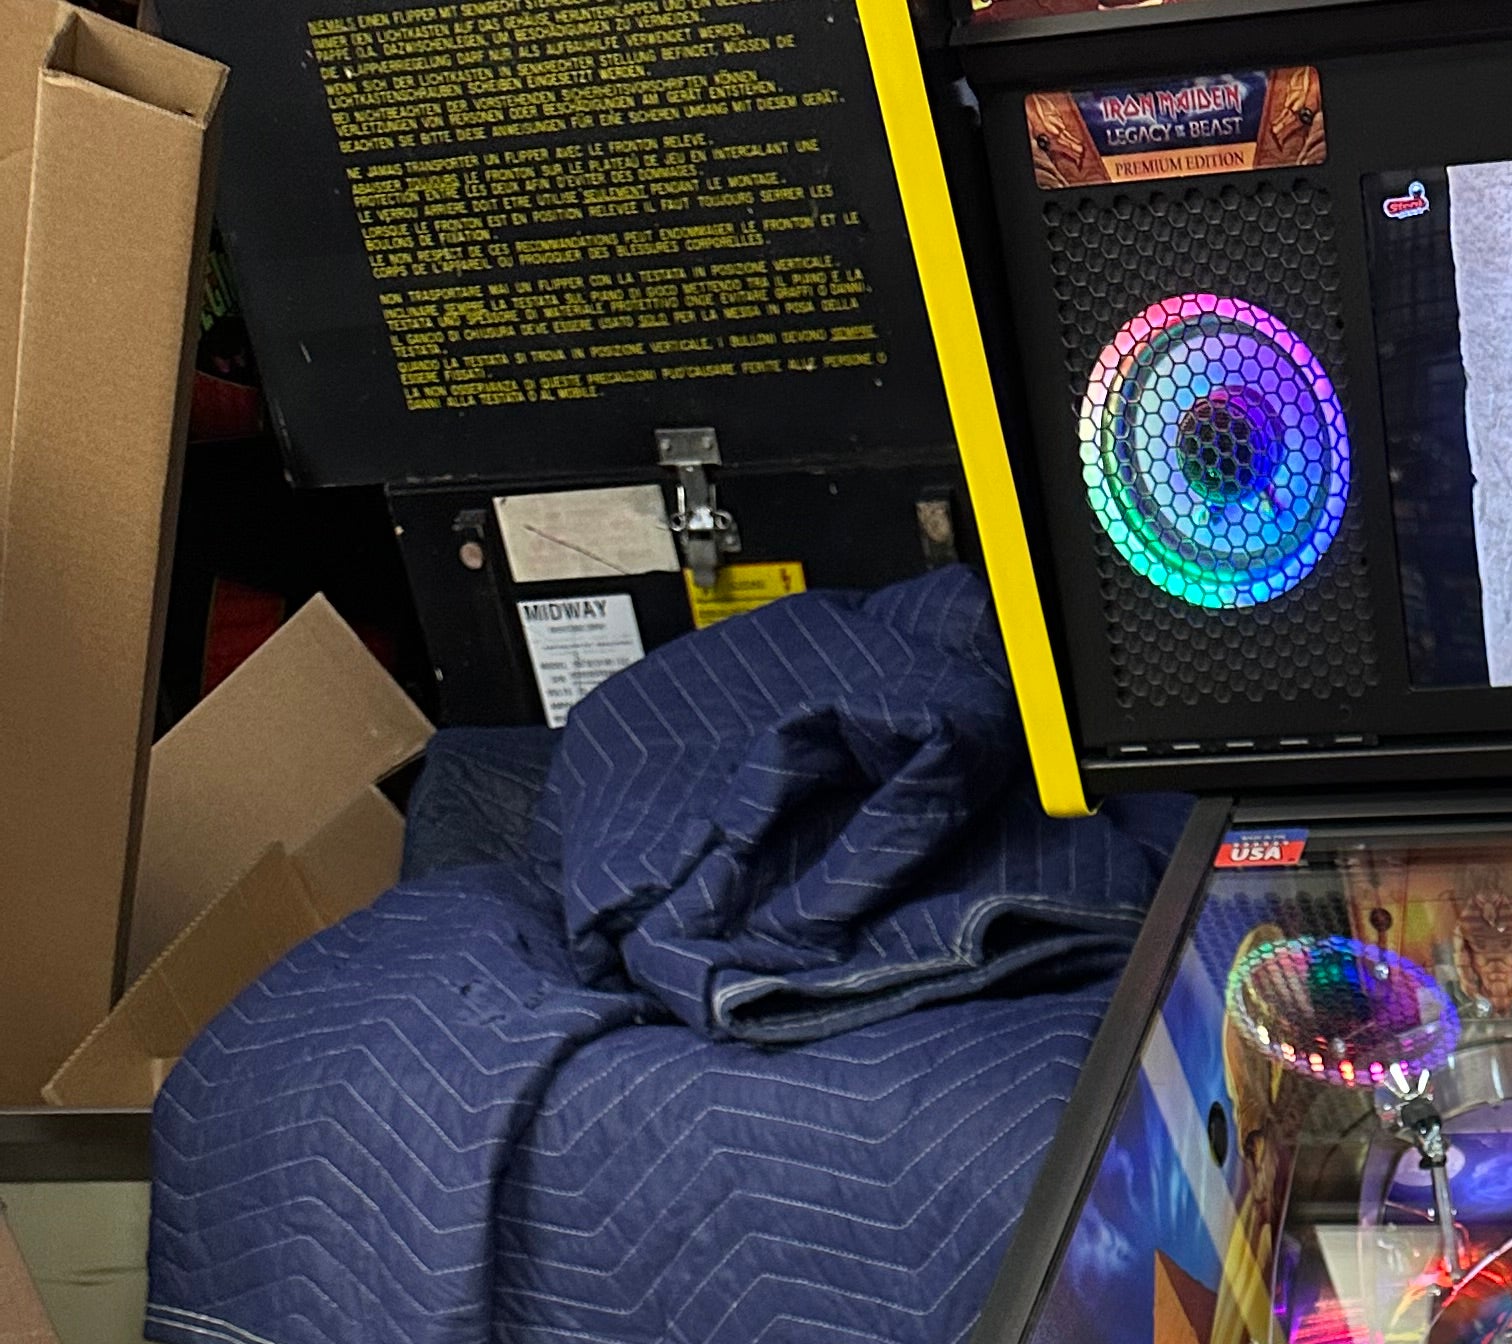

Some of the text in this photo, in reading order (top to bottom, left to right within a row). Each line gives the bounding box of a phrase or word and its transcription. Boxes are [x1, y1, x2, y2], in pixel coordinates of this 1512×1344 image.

[1100, 84, 1244, 125] IRON MAIDEN
[1105, 116, 1244, 146] LEGACY BEAST
[1115, 150, 1245, 178] PREMIUM EDITION
[523, 600, 608, 621] MIDWAY
[1230, 846, 1283, 862] USA
